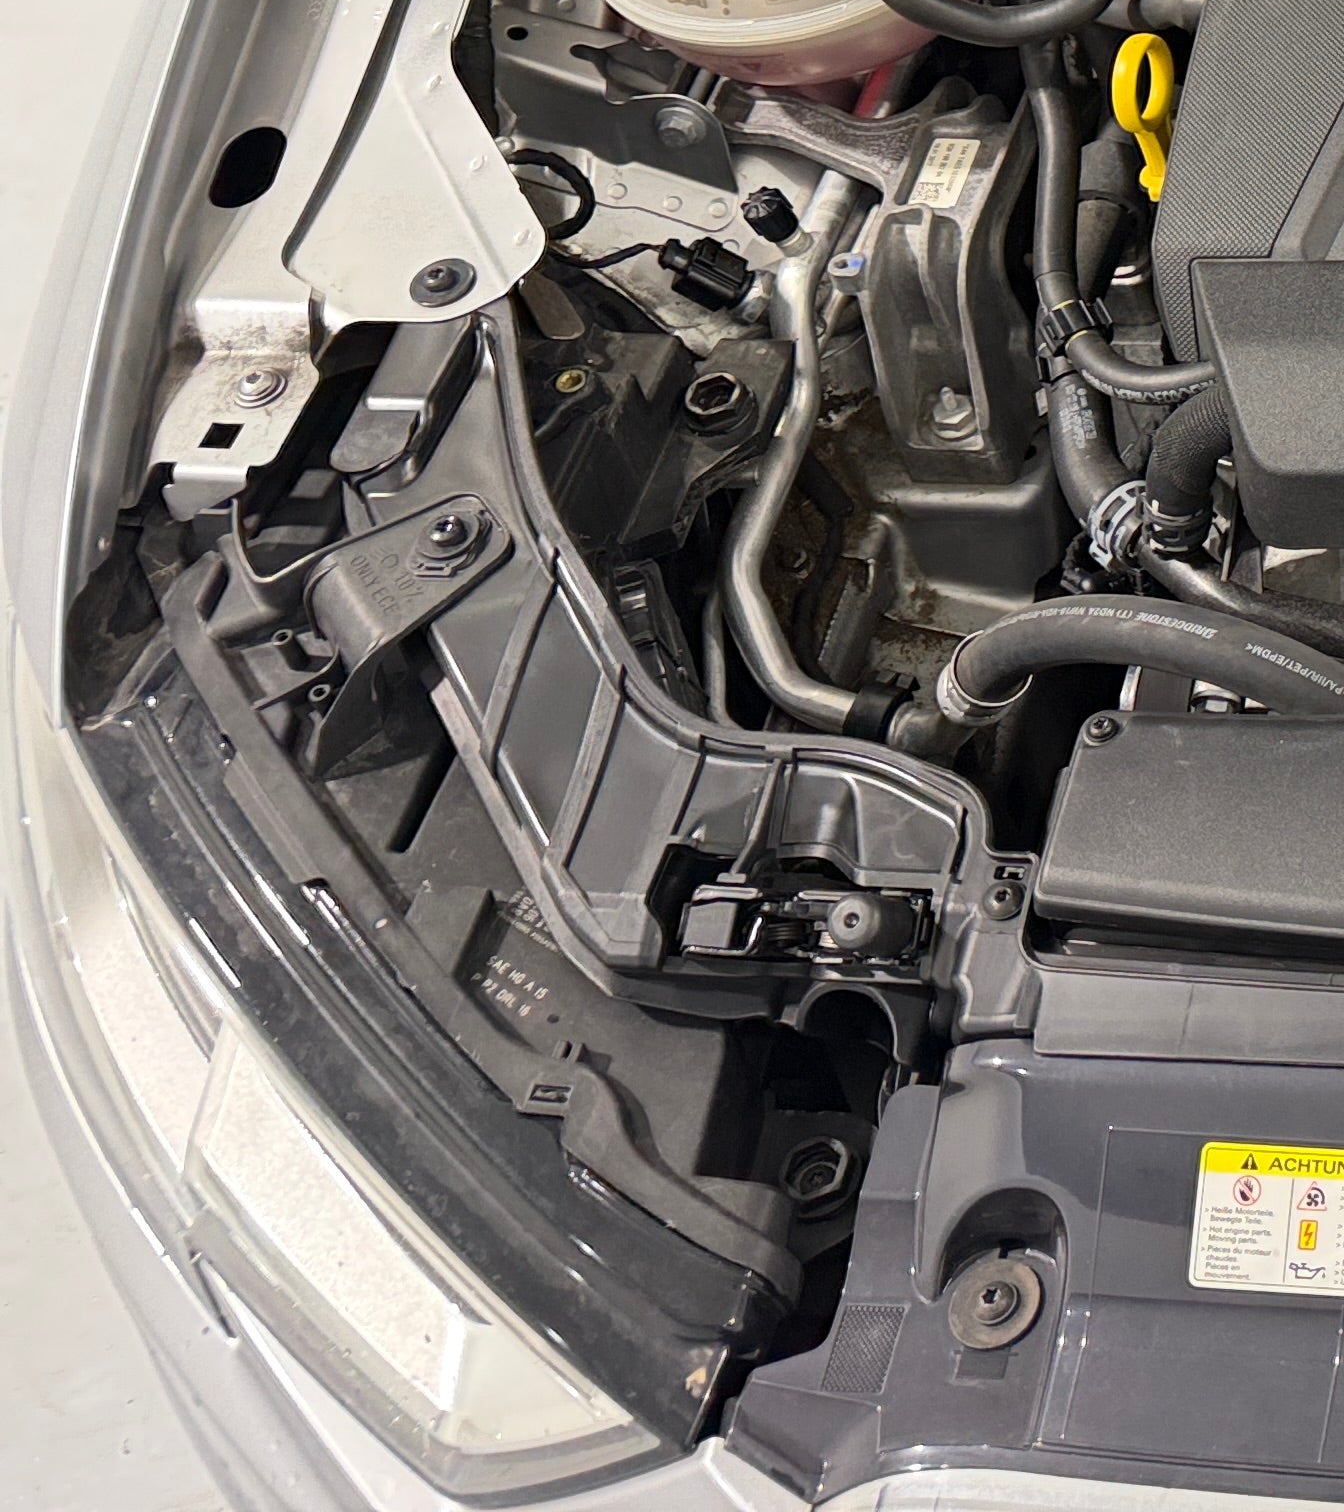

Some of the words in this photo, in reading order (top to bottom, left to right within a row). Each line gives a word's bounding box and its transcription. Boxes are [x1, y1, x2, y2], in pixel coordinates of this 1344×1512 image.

[351, 555, 380, 588] ONLY
[372, 588, 399, 614] ECE
[1137, 611, 1218, 640] BRIDGESTONE
[486, 955, 511, 975] SAE
[523, 980, 535, 992] A
